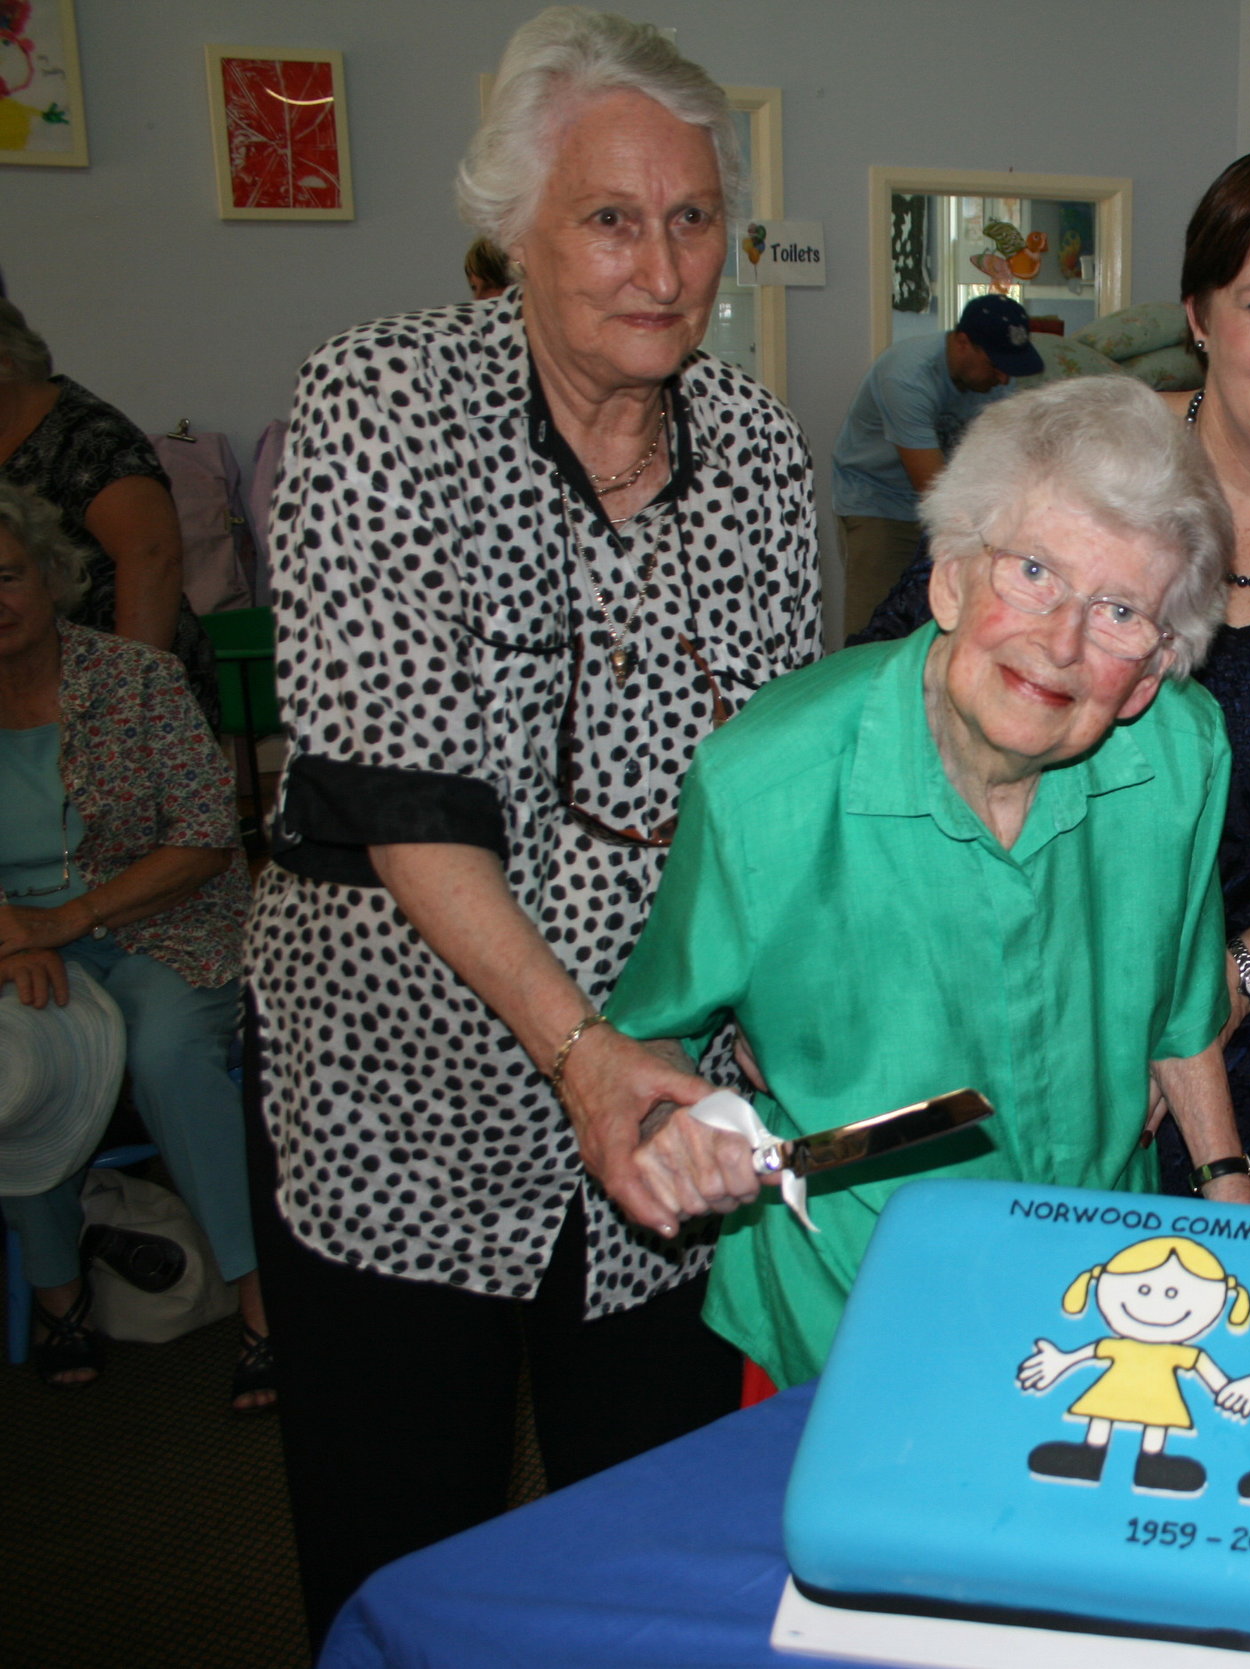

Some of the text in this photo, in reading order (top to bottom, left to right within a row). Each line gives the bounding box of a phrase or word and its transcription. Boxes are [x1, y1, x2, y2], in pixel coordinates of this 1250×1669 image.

[771, 243, 820, 262] Toilets
[1009, 1199, 1162, 1232] NORWOOD
[1126, 1517, 1198, 1549] 1959
